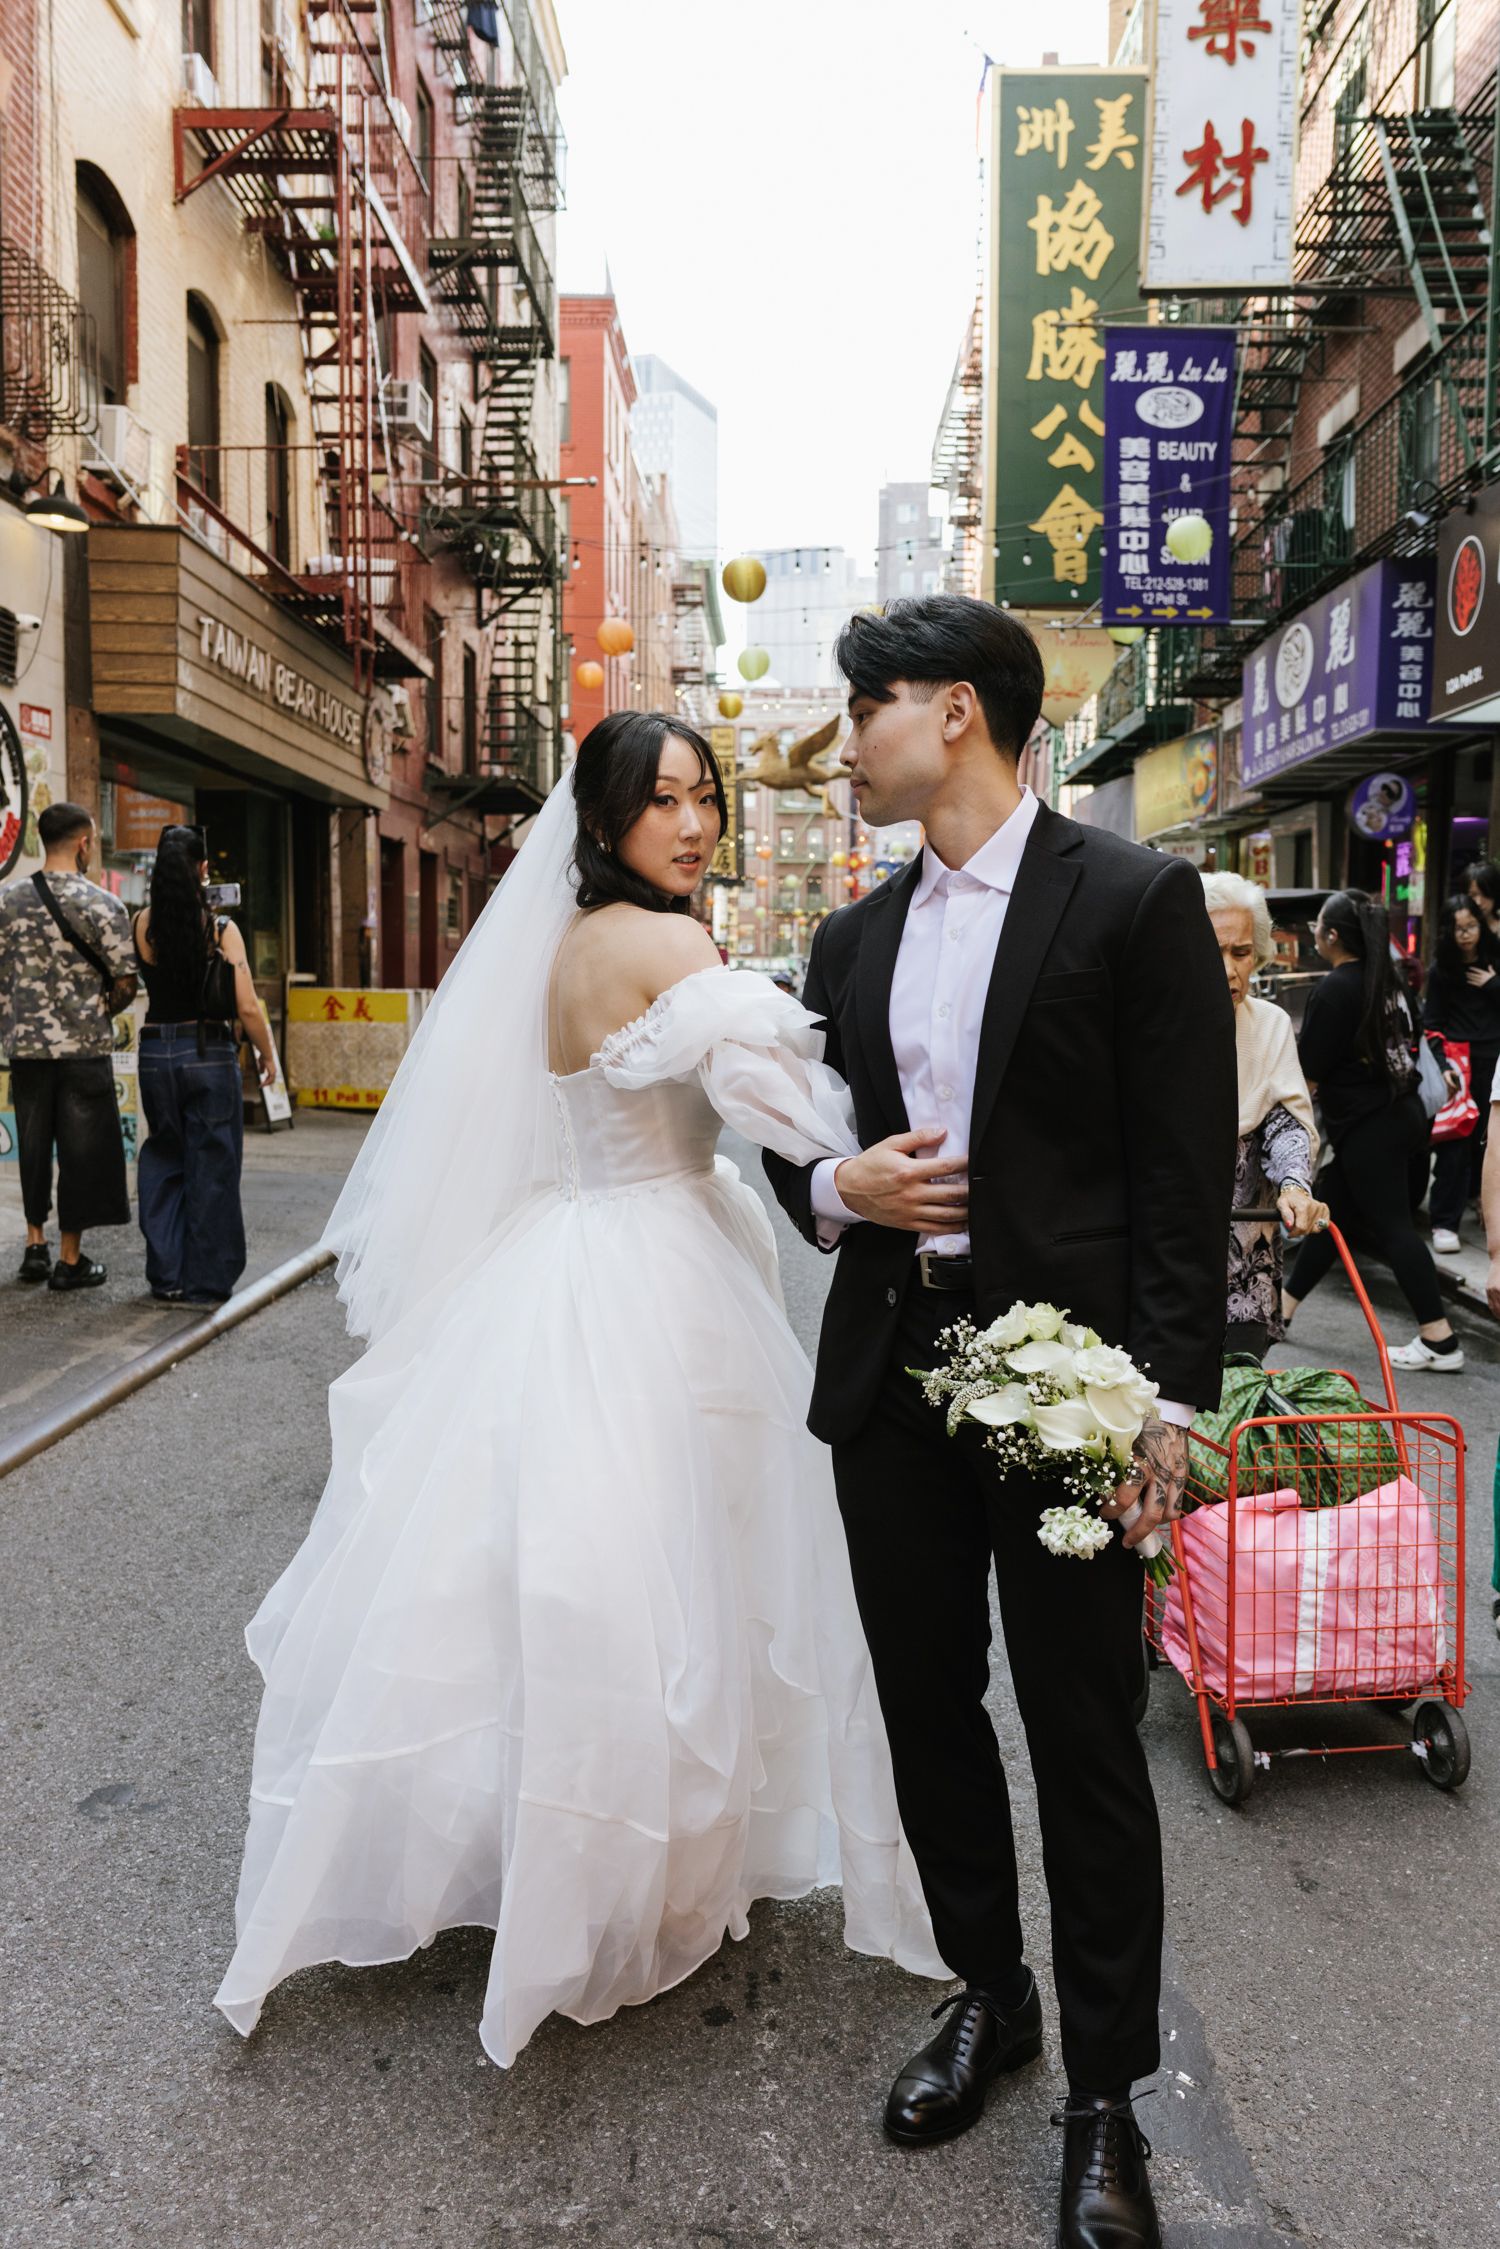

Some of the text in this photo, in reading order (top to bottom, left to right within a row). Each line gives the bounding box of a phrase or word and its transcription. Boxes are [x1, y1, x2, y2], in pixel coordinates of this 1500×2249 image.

[1157, 440, 1218, 461] BEAUTY
[1179, 473, 1192, 493] &
[199, 616, 361, 745] TAIWAN BEAR HOUSE
[313, 1088, 329, 1103] 11
